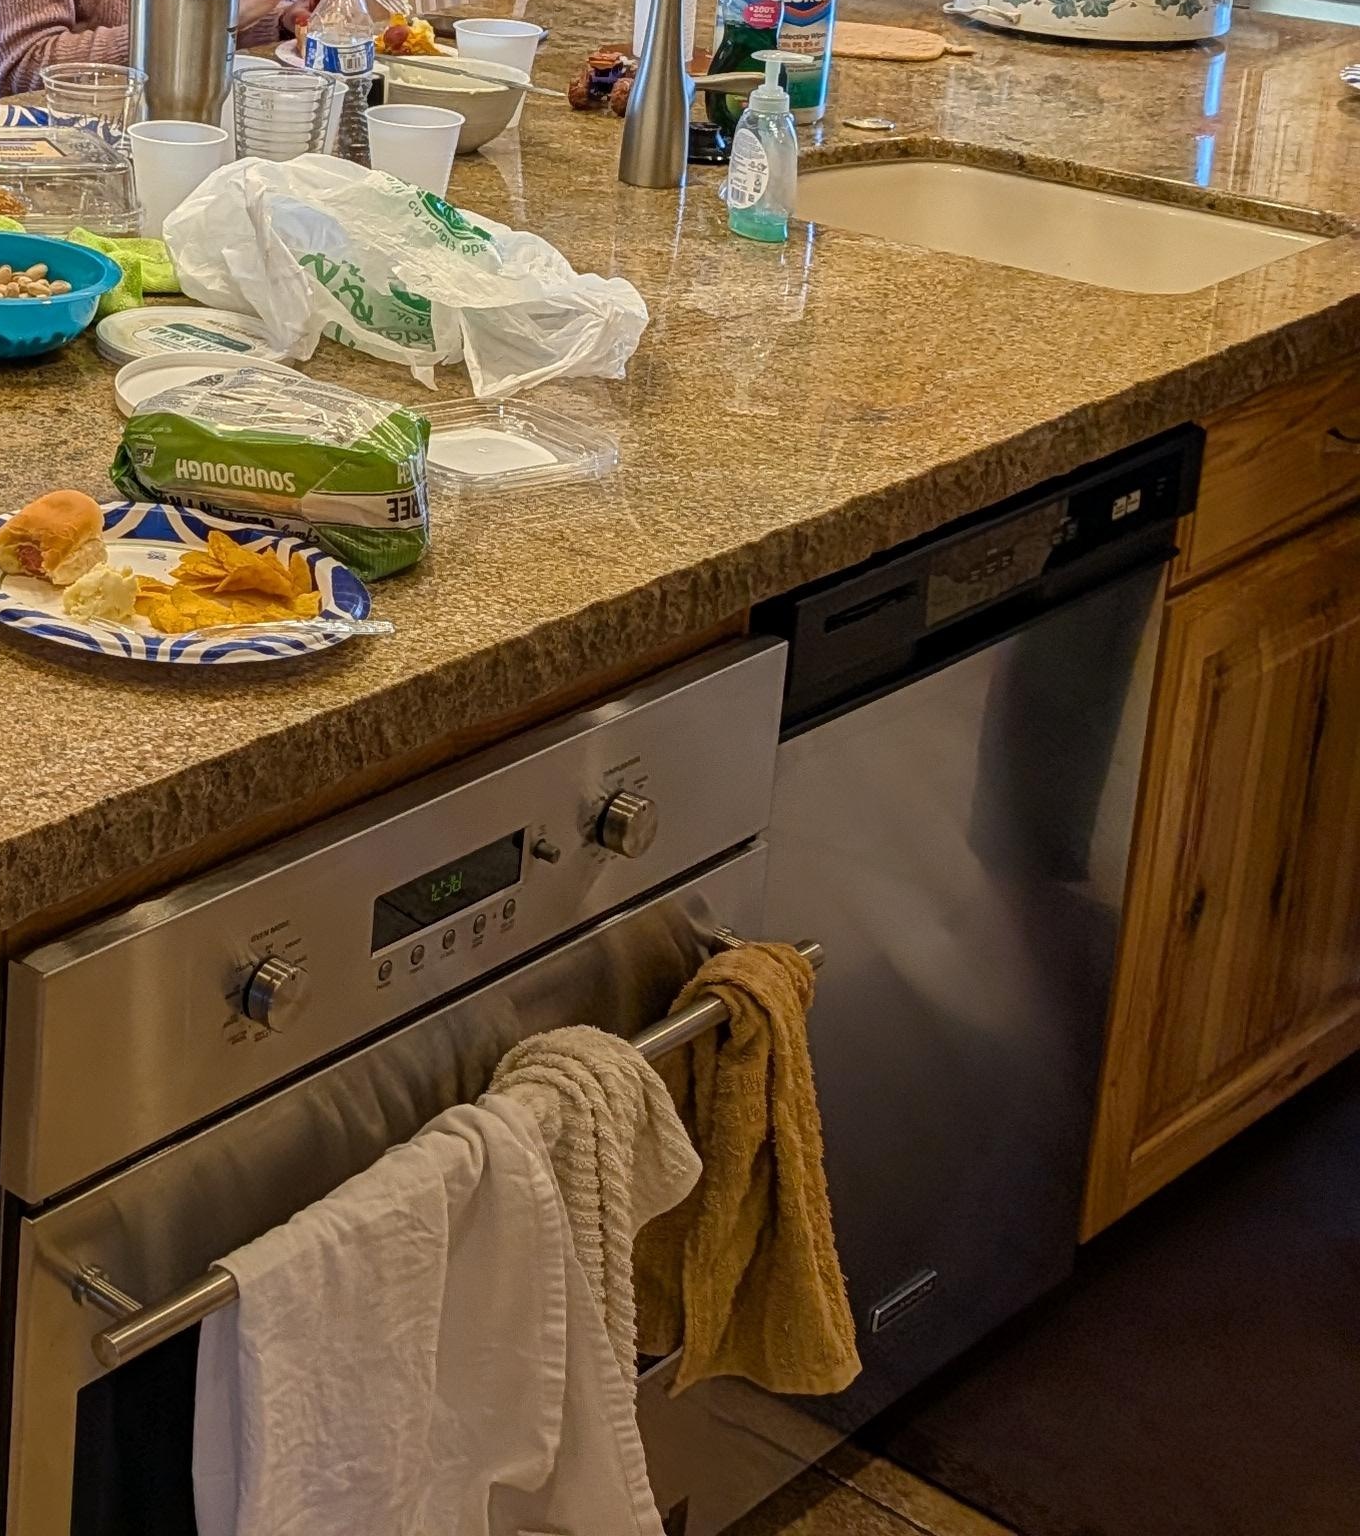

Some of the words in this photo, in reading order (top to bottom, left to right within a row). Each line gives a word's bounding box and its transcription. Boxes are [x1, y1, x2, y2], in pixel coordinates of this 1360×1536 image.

[408, 200, 423, 218] to
[422, 217, 457, 252] flavor
[461, 243, 488, 257] add
[175, 458, 297, 493] SOURDOUGH
[387, 494, 422, 522] REE
